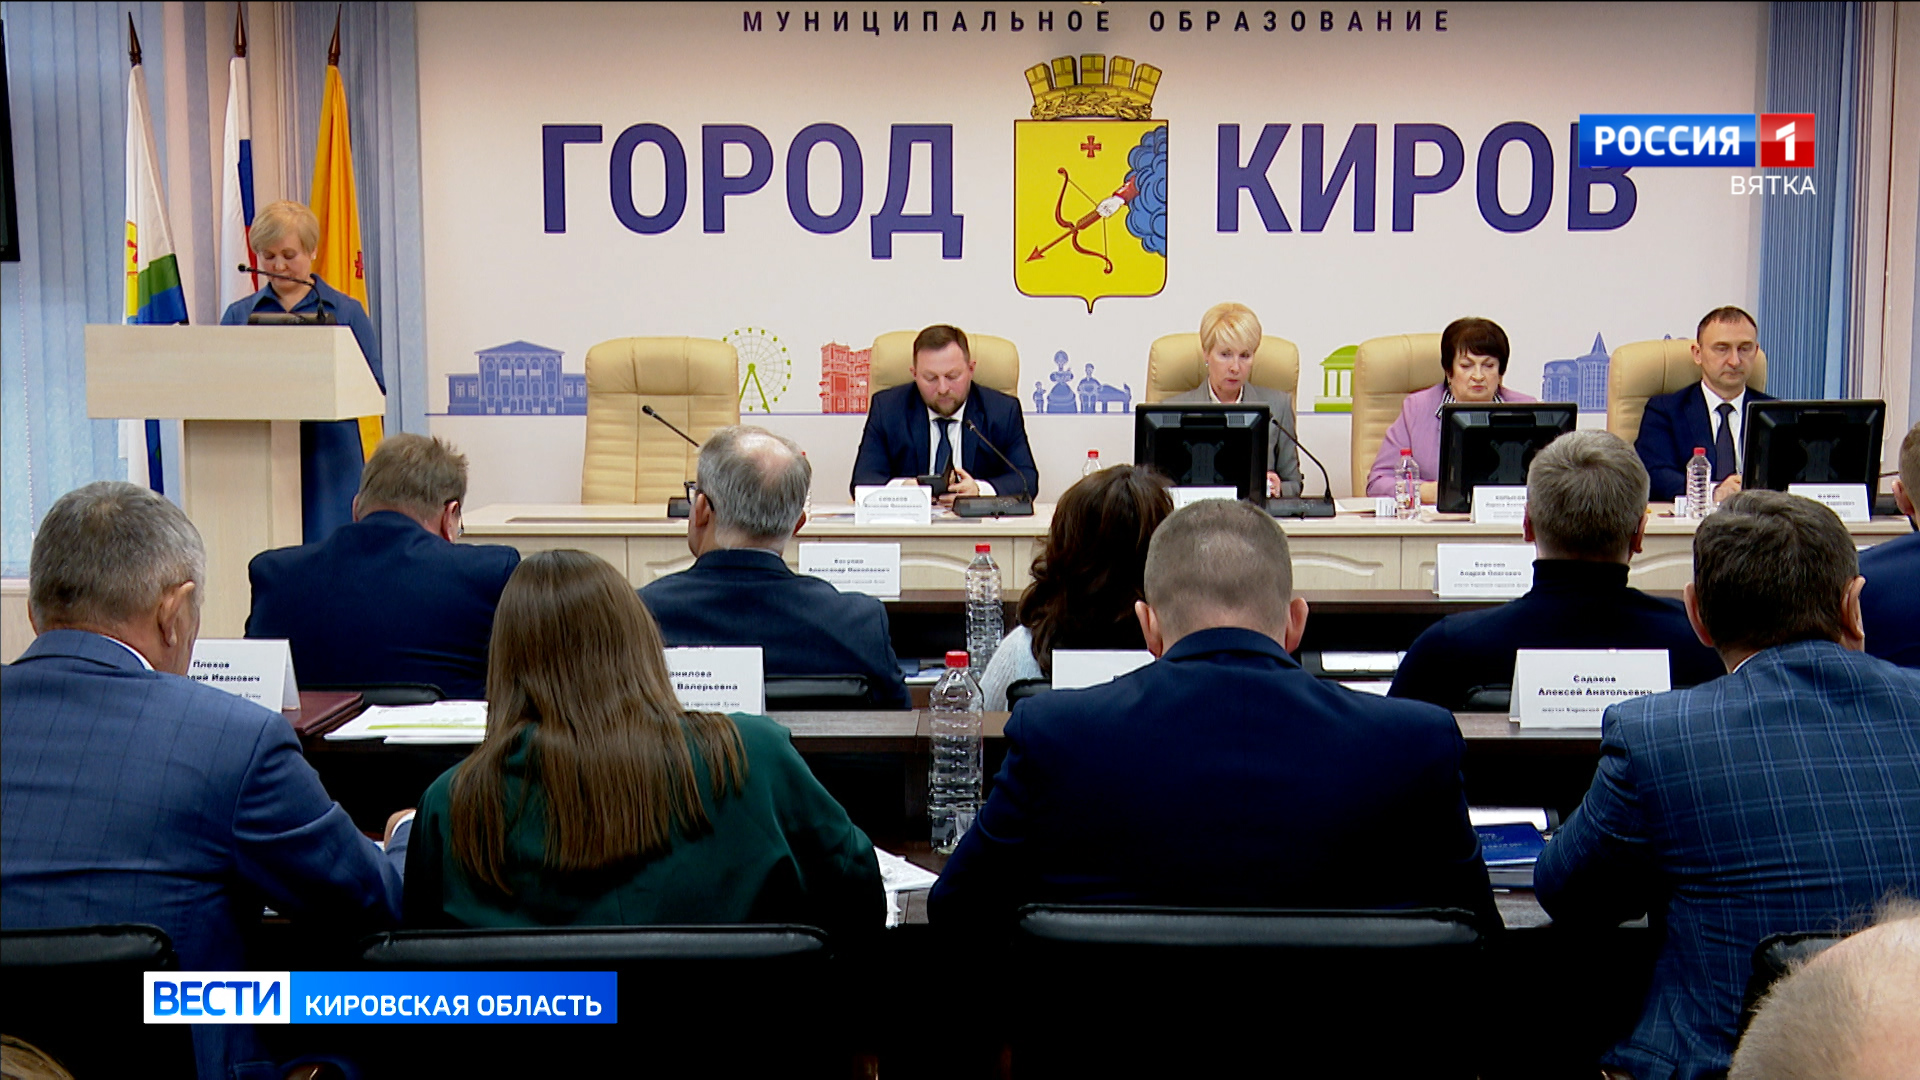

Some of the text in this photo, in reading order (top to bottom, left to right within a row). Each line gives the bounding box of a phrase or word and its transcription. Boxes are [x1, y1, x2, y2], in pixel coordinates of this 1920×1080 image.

[743, 9, 1449, 36] МУНИЦИПАЛЬНОЕ ОБРАЗОВАНИЕ
[541, 121, 1638, 260] ГОРОД КИРОВ
[1538, 687, 1583, 696] Алексей
